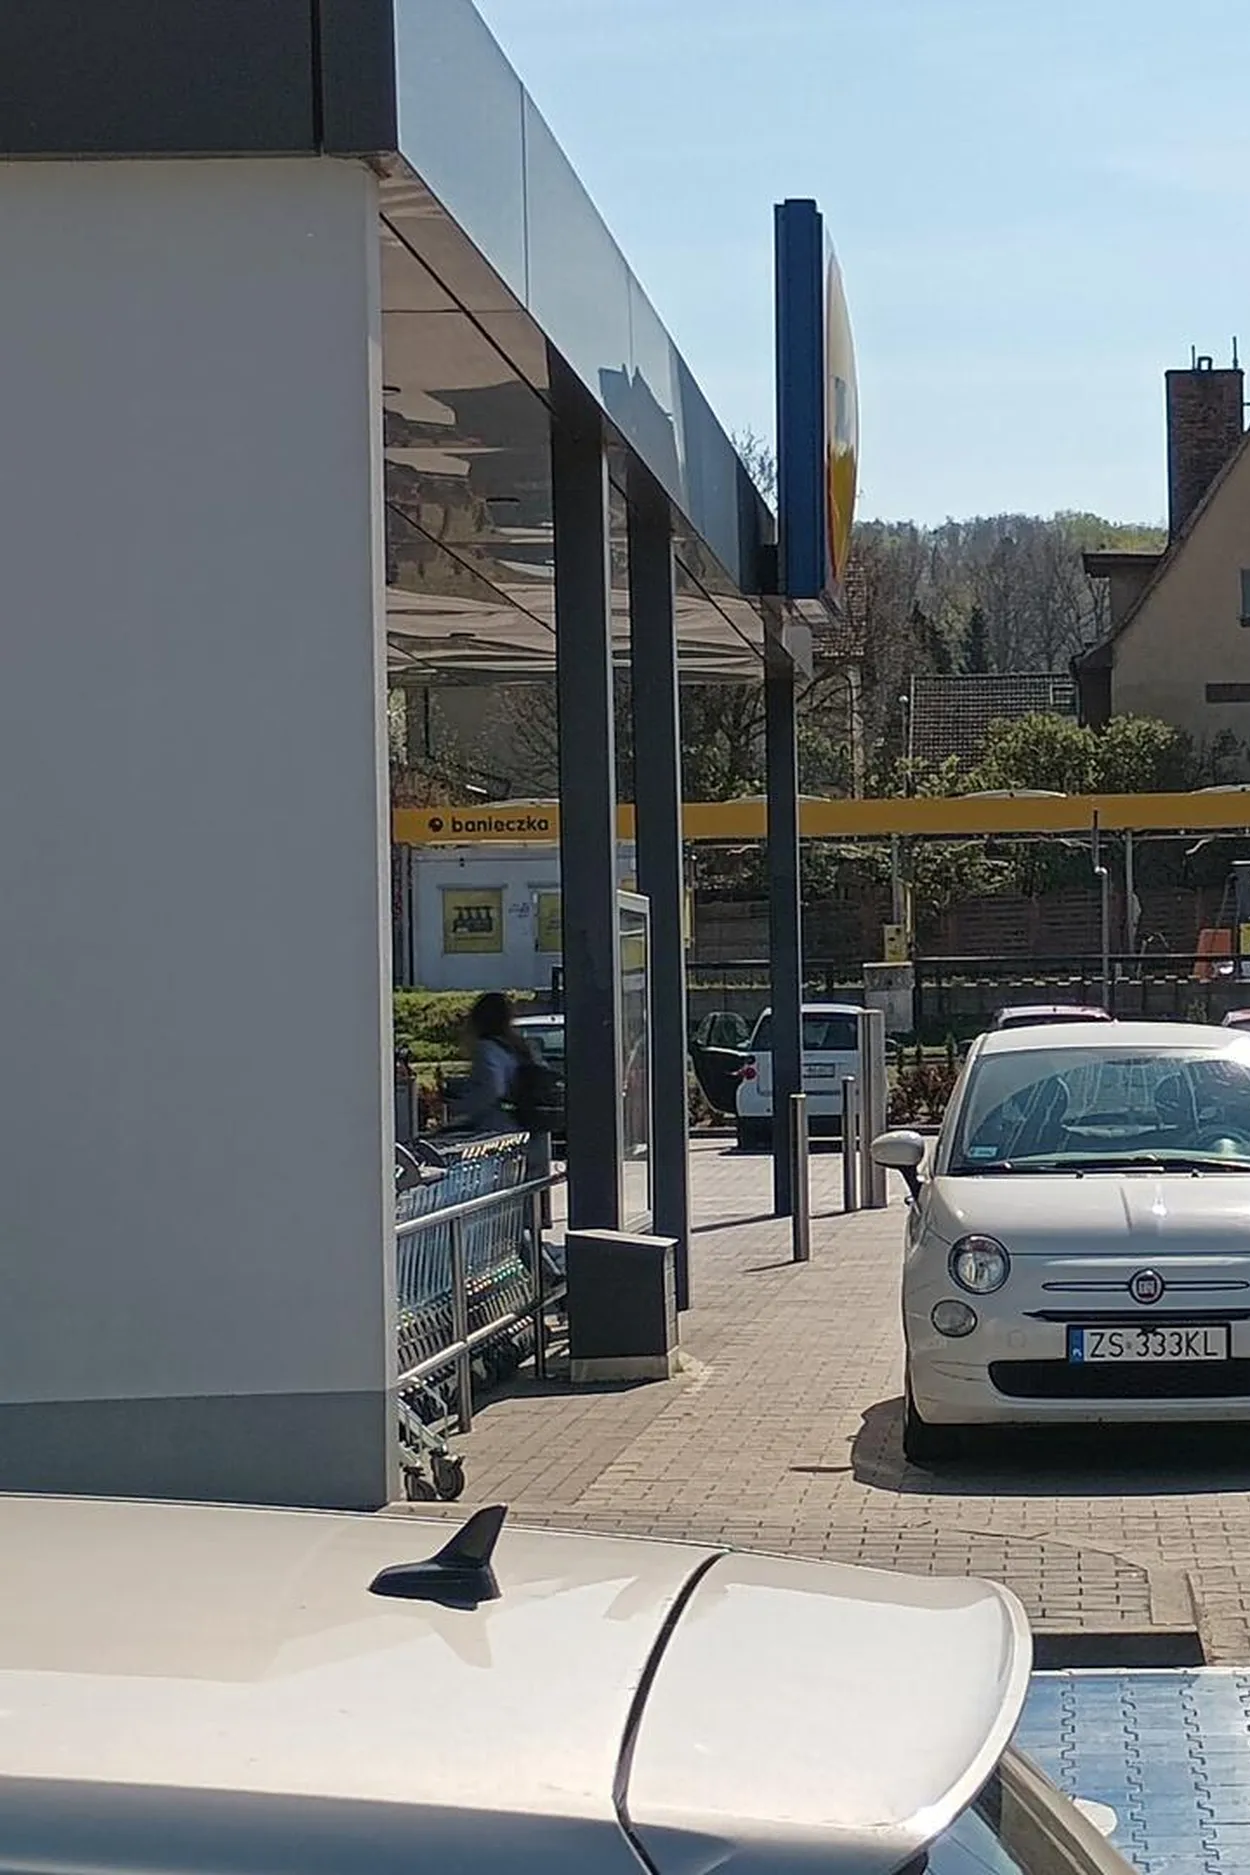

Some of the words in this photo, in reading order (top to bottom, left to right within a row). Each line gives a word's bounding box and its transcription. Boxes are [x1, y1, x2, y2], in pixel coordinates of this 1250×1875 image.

[451, 816, 549, 832] banieczka
[1089, 1331, 1124, 1358] ZS
[1136, 1330, 1218, 1358] 333KL
